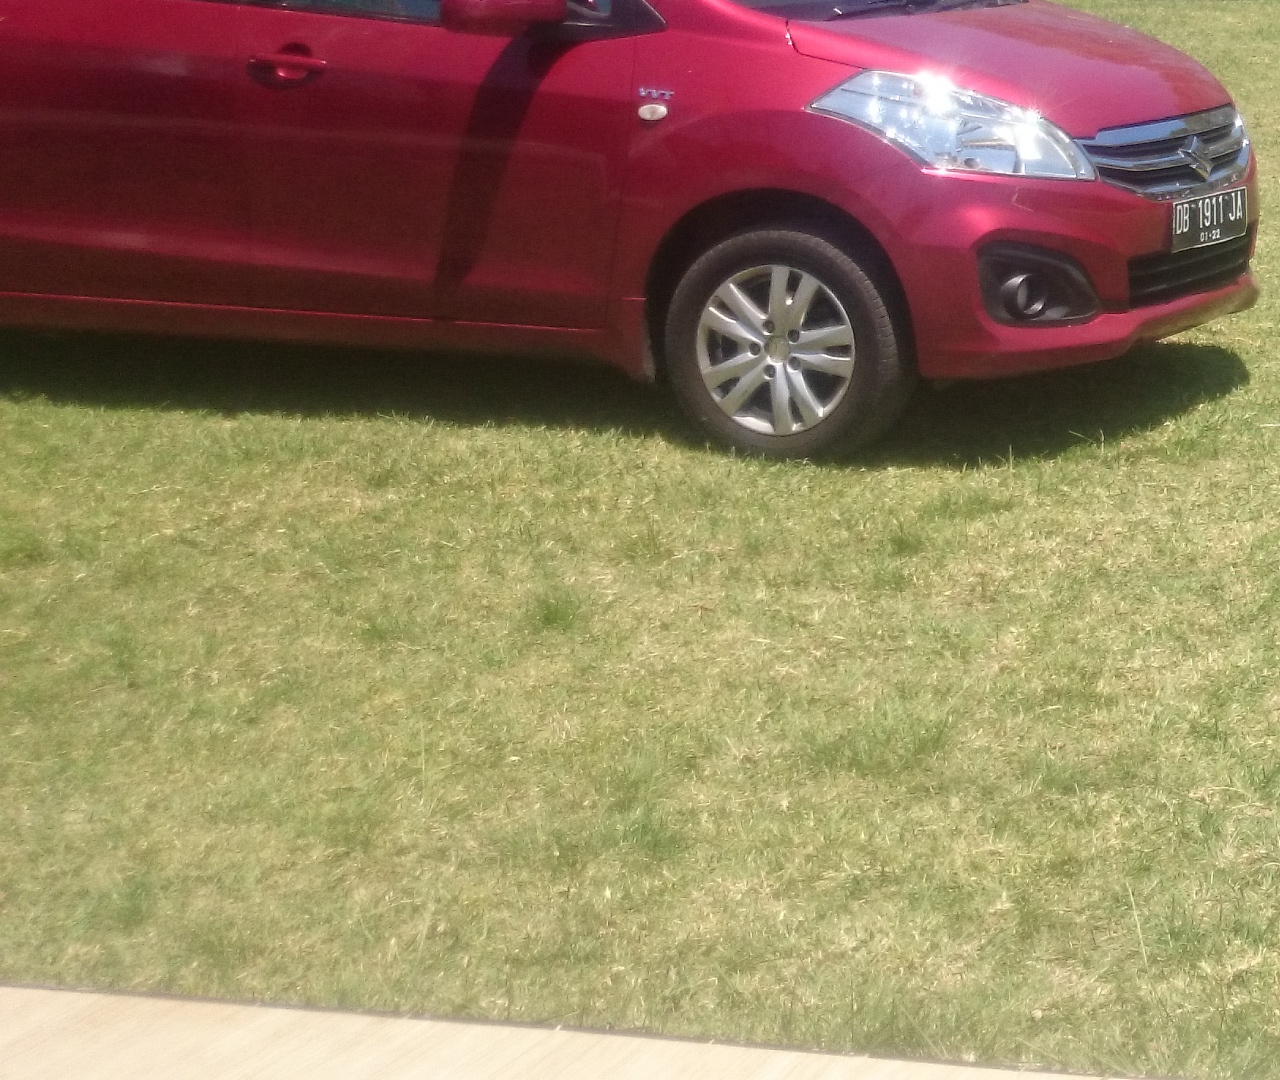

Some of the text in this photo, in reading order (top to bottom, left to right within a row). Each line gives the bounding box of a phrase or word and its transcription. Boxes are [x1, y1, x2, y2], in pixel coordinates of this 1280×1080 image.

[1176, 190, 1243, 235] DB 1911 JA
